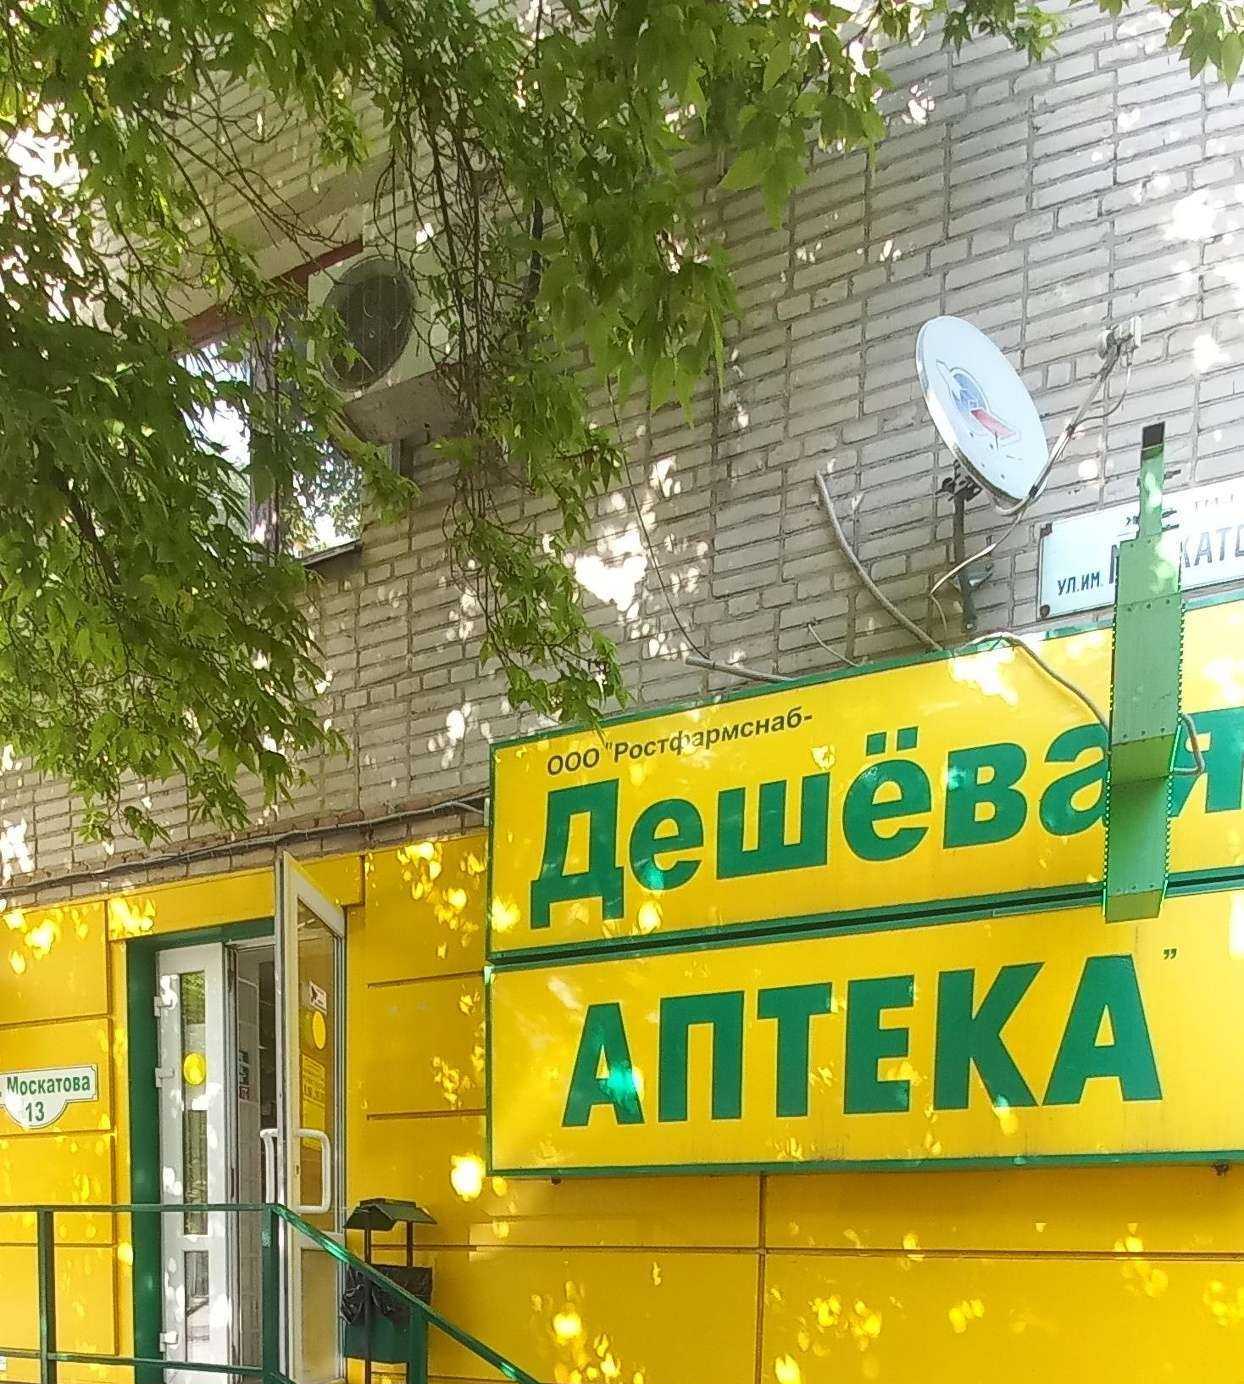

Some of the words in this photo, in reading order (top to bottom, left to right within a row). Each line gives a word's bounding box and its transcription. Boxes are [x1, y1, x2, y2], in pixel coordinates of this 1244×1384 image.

[547, 747, 600, 775] ООО
[530, 706, 1244, 929] Дешёвая
[6, 1075, 91, 1096] Москатова
[25, 1101, 45, 1122] 13
